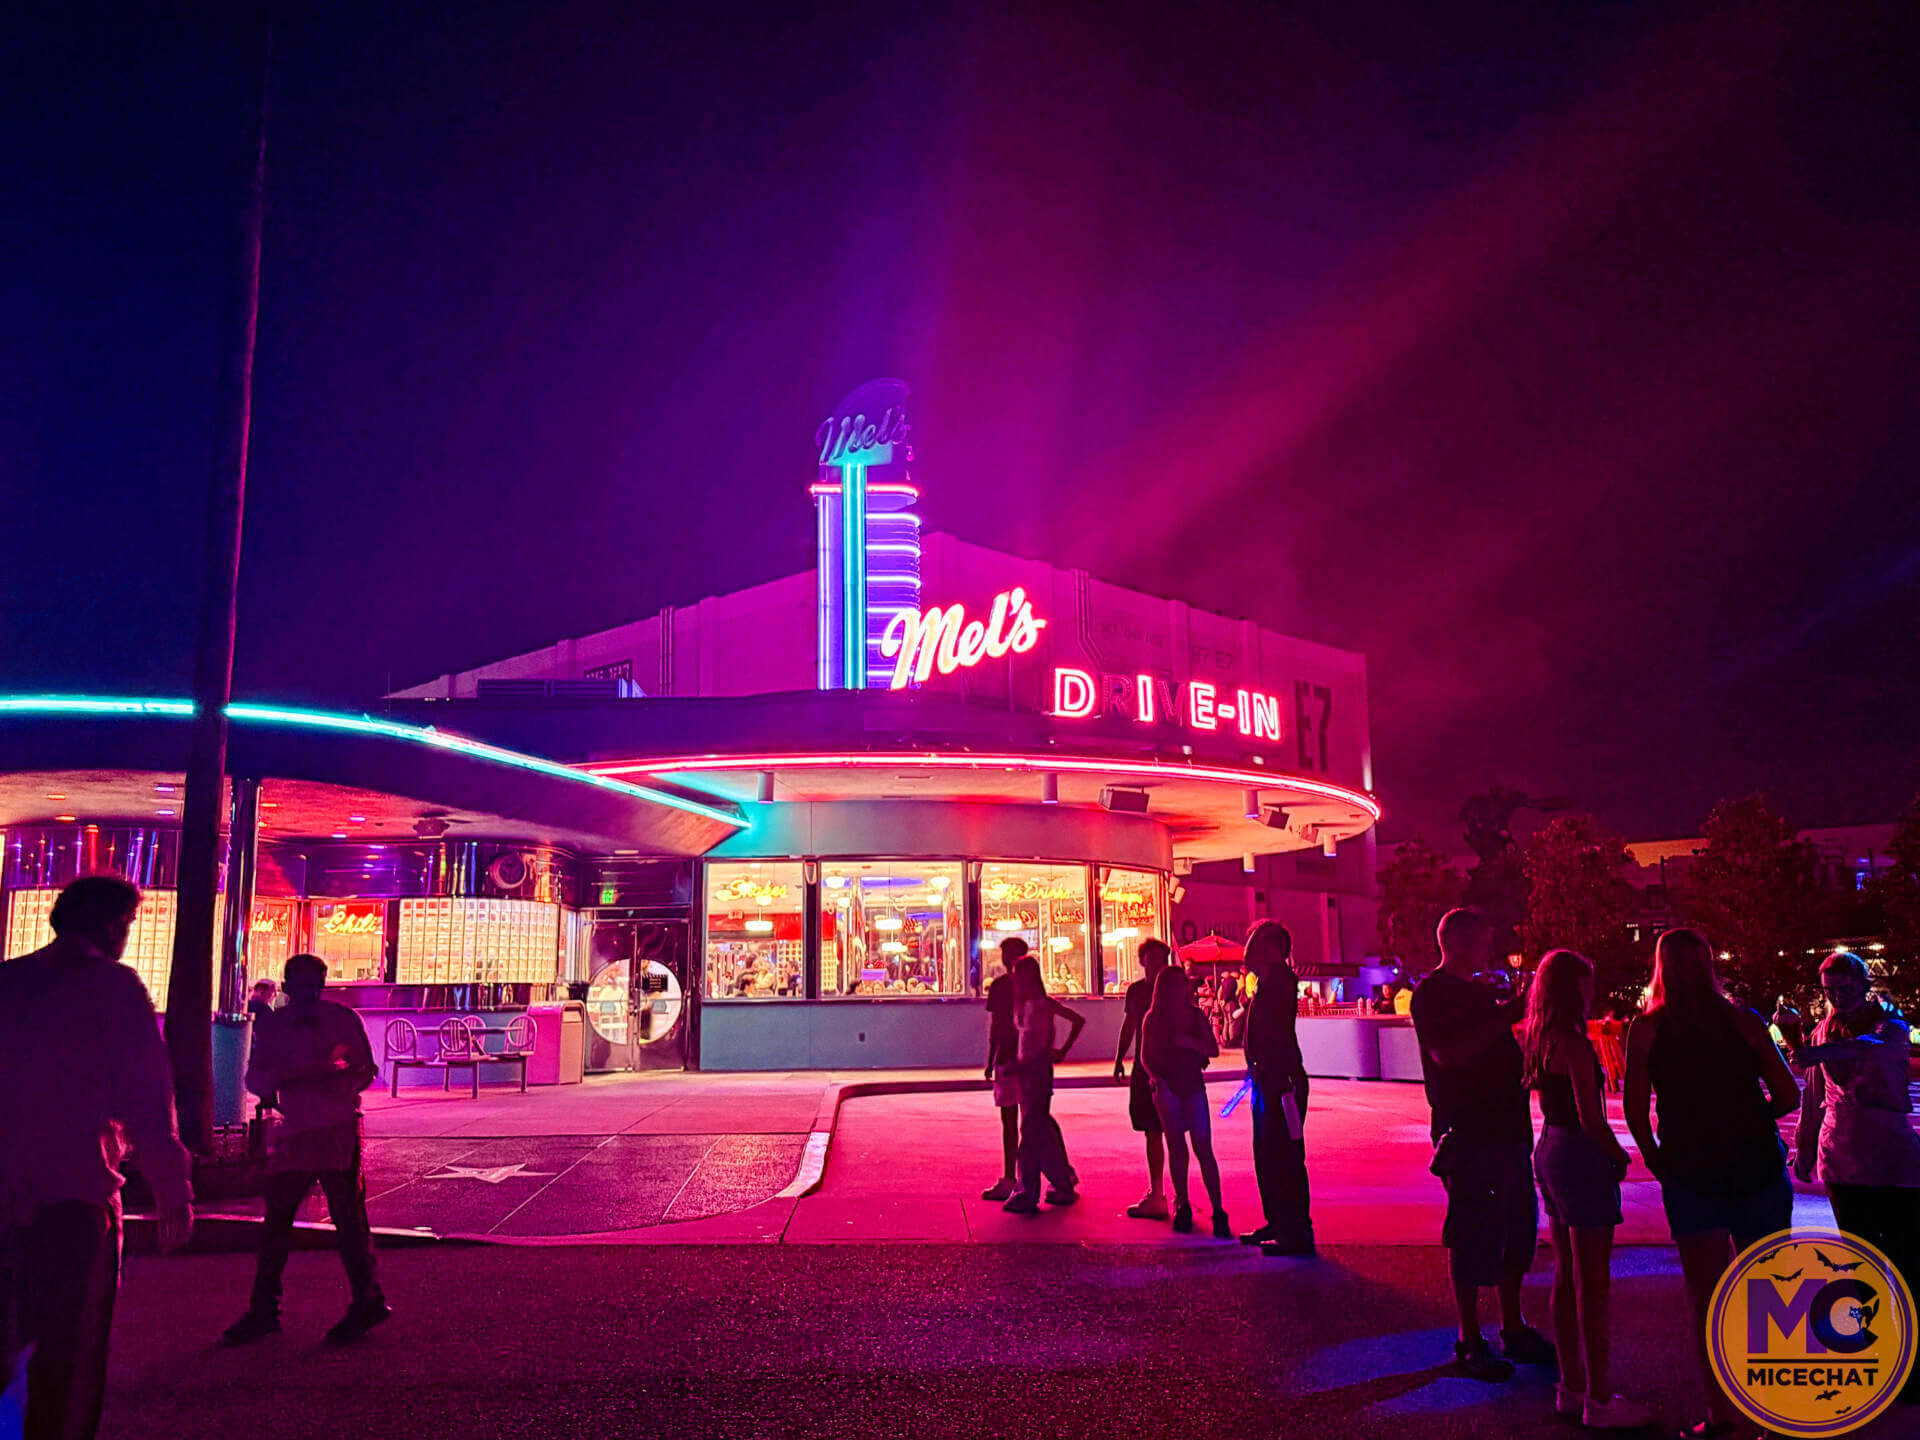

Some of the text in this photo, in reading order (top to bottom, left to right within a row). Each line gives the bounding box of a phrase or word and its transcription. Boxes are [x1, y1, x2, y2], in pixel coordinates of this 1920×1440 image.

[880, 586, 1047, 690] Mel's
[1054, 667, 1281, 742] DRIVE-IN
[325, 910, 378, 934] Chili
